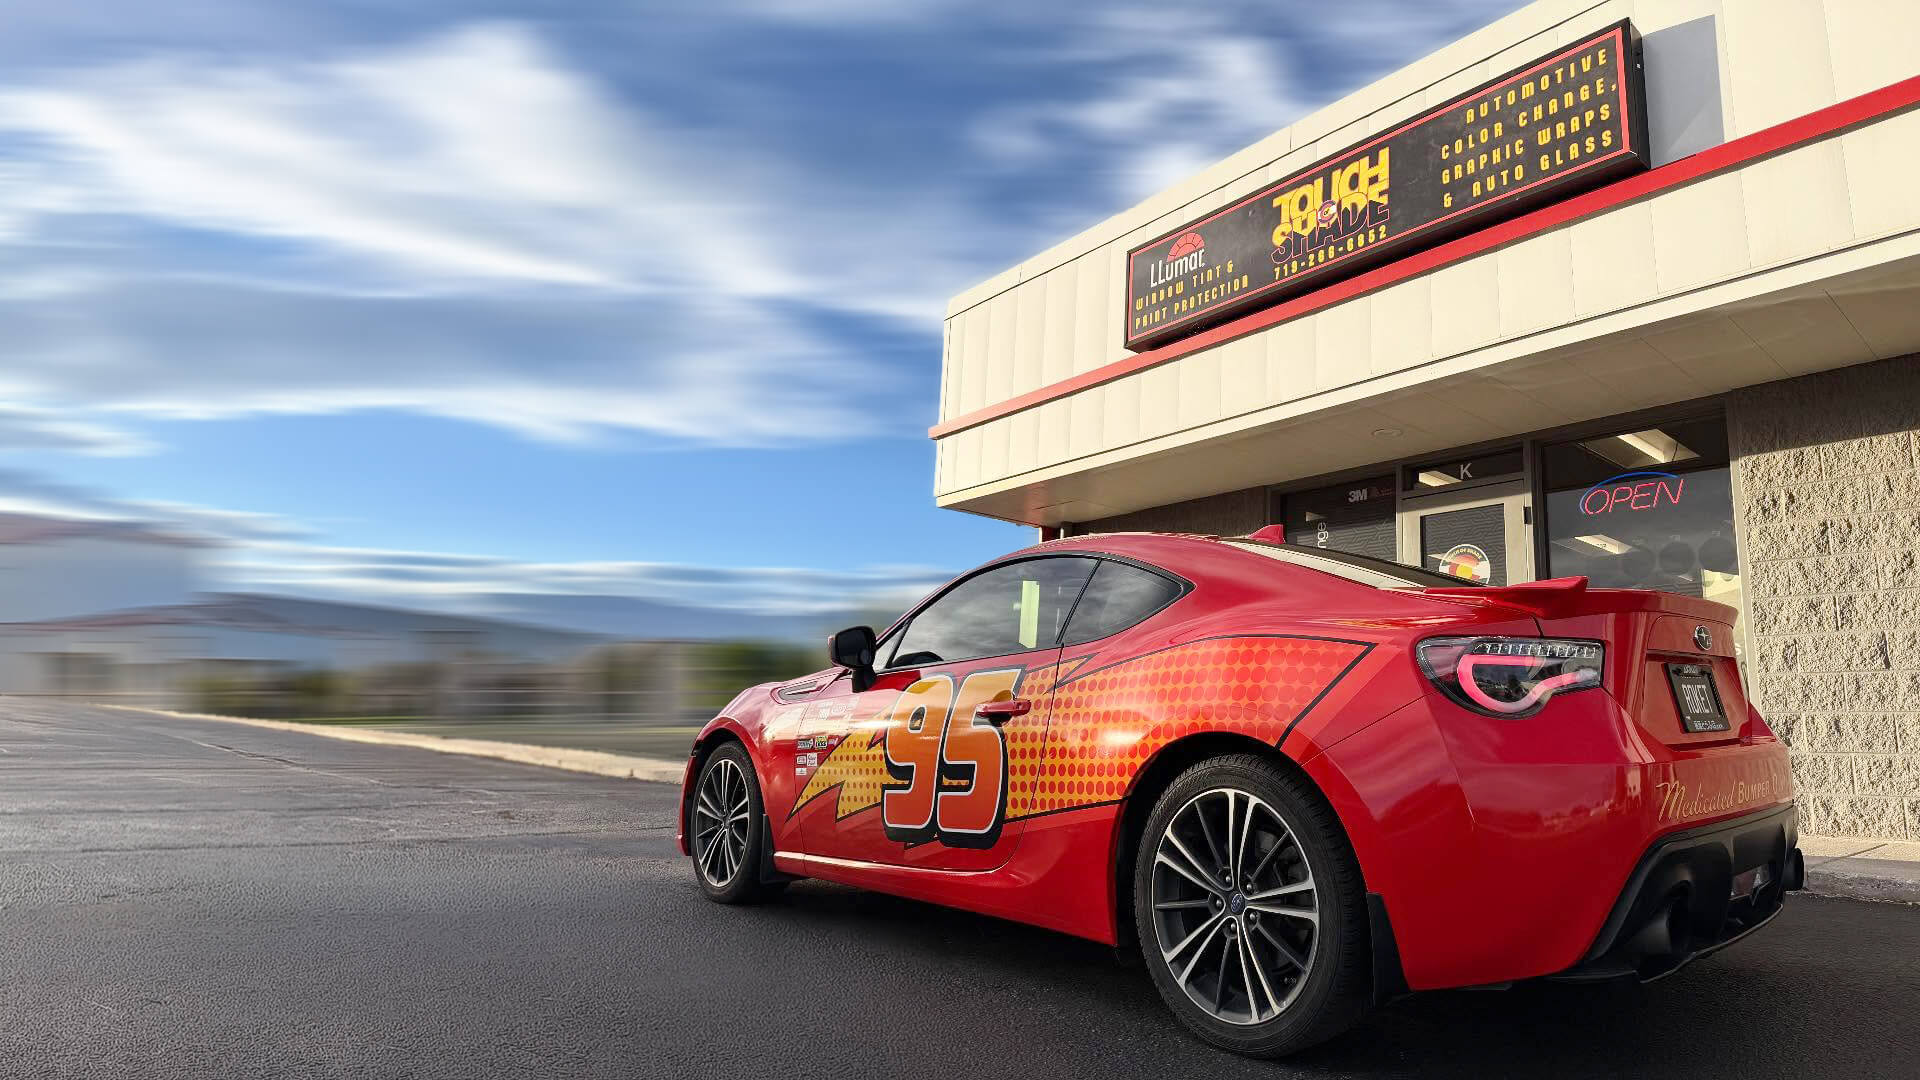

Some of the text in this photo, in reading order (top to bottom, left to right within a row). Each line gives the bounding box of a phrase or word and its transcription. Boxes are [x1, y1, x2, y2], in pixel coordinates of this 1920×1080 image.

[1441, 77, 1617, 160] COLOR CHANGE,
[1466, 48, 1607, 123] AUTOMOTIVE
[1442, 103, 1610, 185] GRAPHIC WRAPS
[1443, 129, 1613, 208] & AUTO GLASS
[1271, 179, 1390, 264] SHADE
[1272, 147, 1390, 224] TOUCH
[1135, 280, 1184, 311] WINDOW
[1192, 264, 1221, 288] TINT
[1135, 274, 1249, 330] PAINT PROTECTION
[1348, 487, 1368, 503] 3M
[1459, 462, 1473, 480] K
[1584, 479, 1684, 515] OPEN
[882, 664, 1026, 848] 95
[1655, 780, 1736, 822] Medicated
